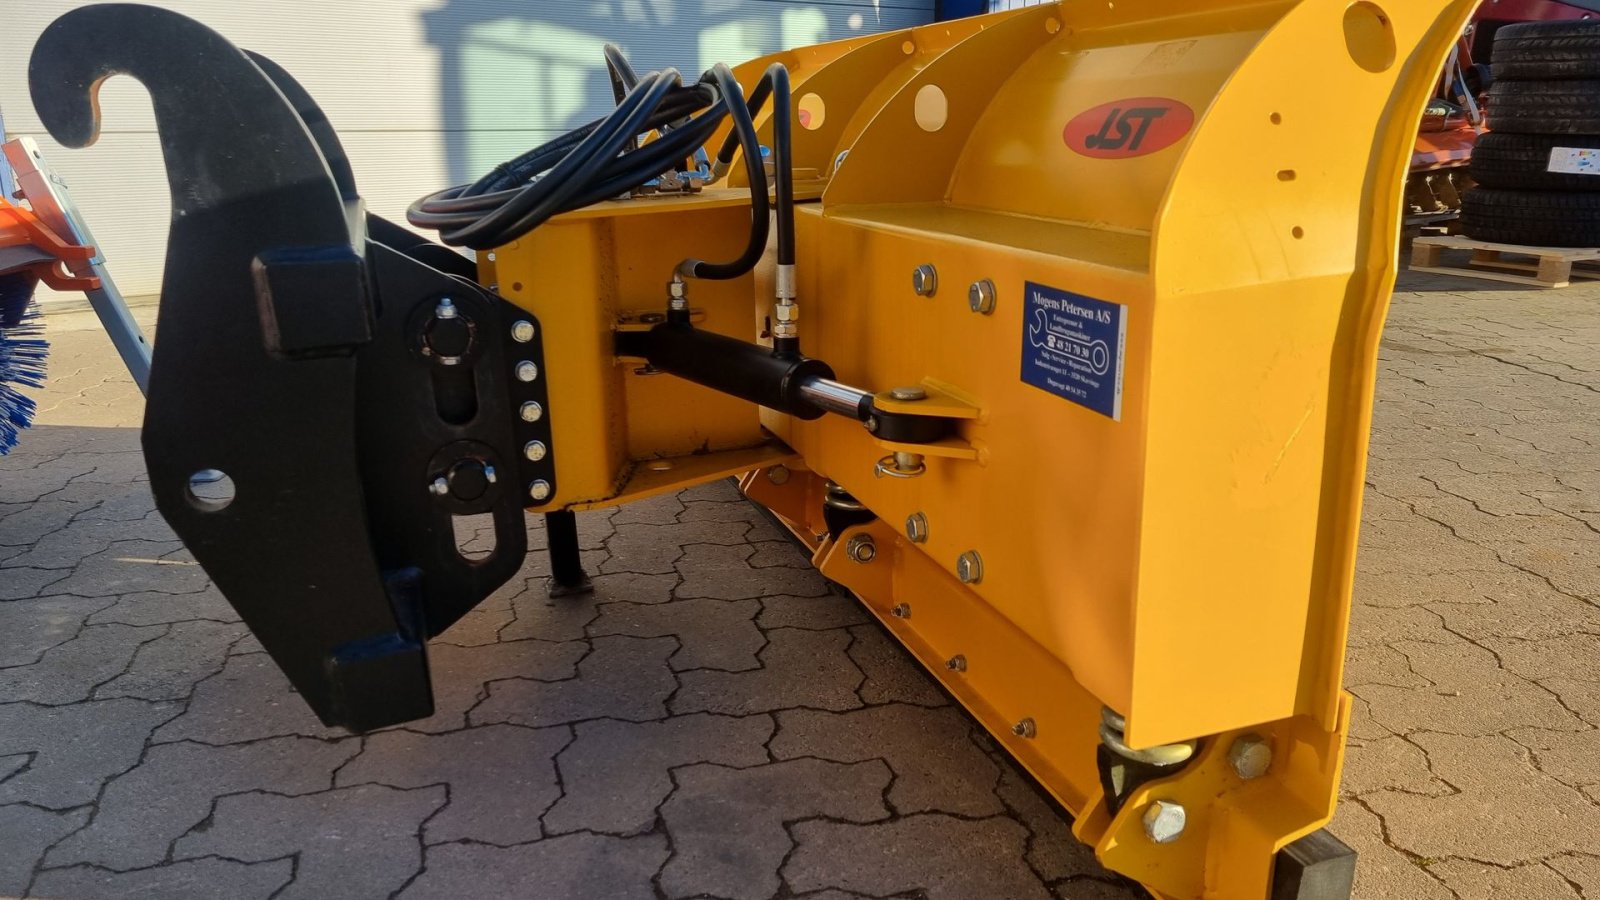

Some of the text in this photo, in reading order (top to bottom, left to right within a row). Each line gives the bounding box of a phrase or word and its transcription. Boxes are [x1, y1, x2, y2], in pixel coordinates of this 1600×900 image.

[1084, 107, 1171, 151] JST
[1032, 291, 1111, 325] Mogens Petersen A/S
[1056, 340, 1090, 358] 48 21 70 30
